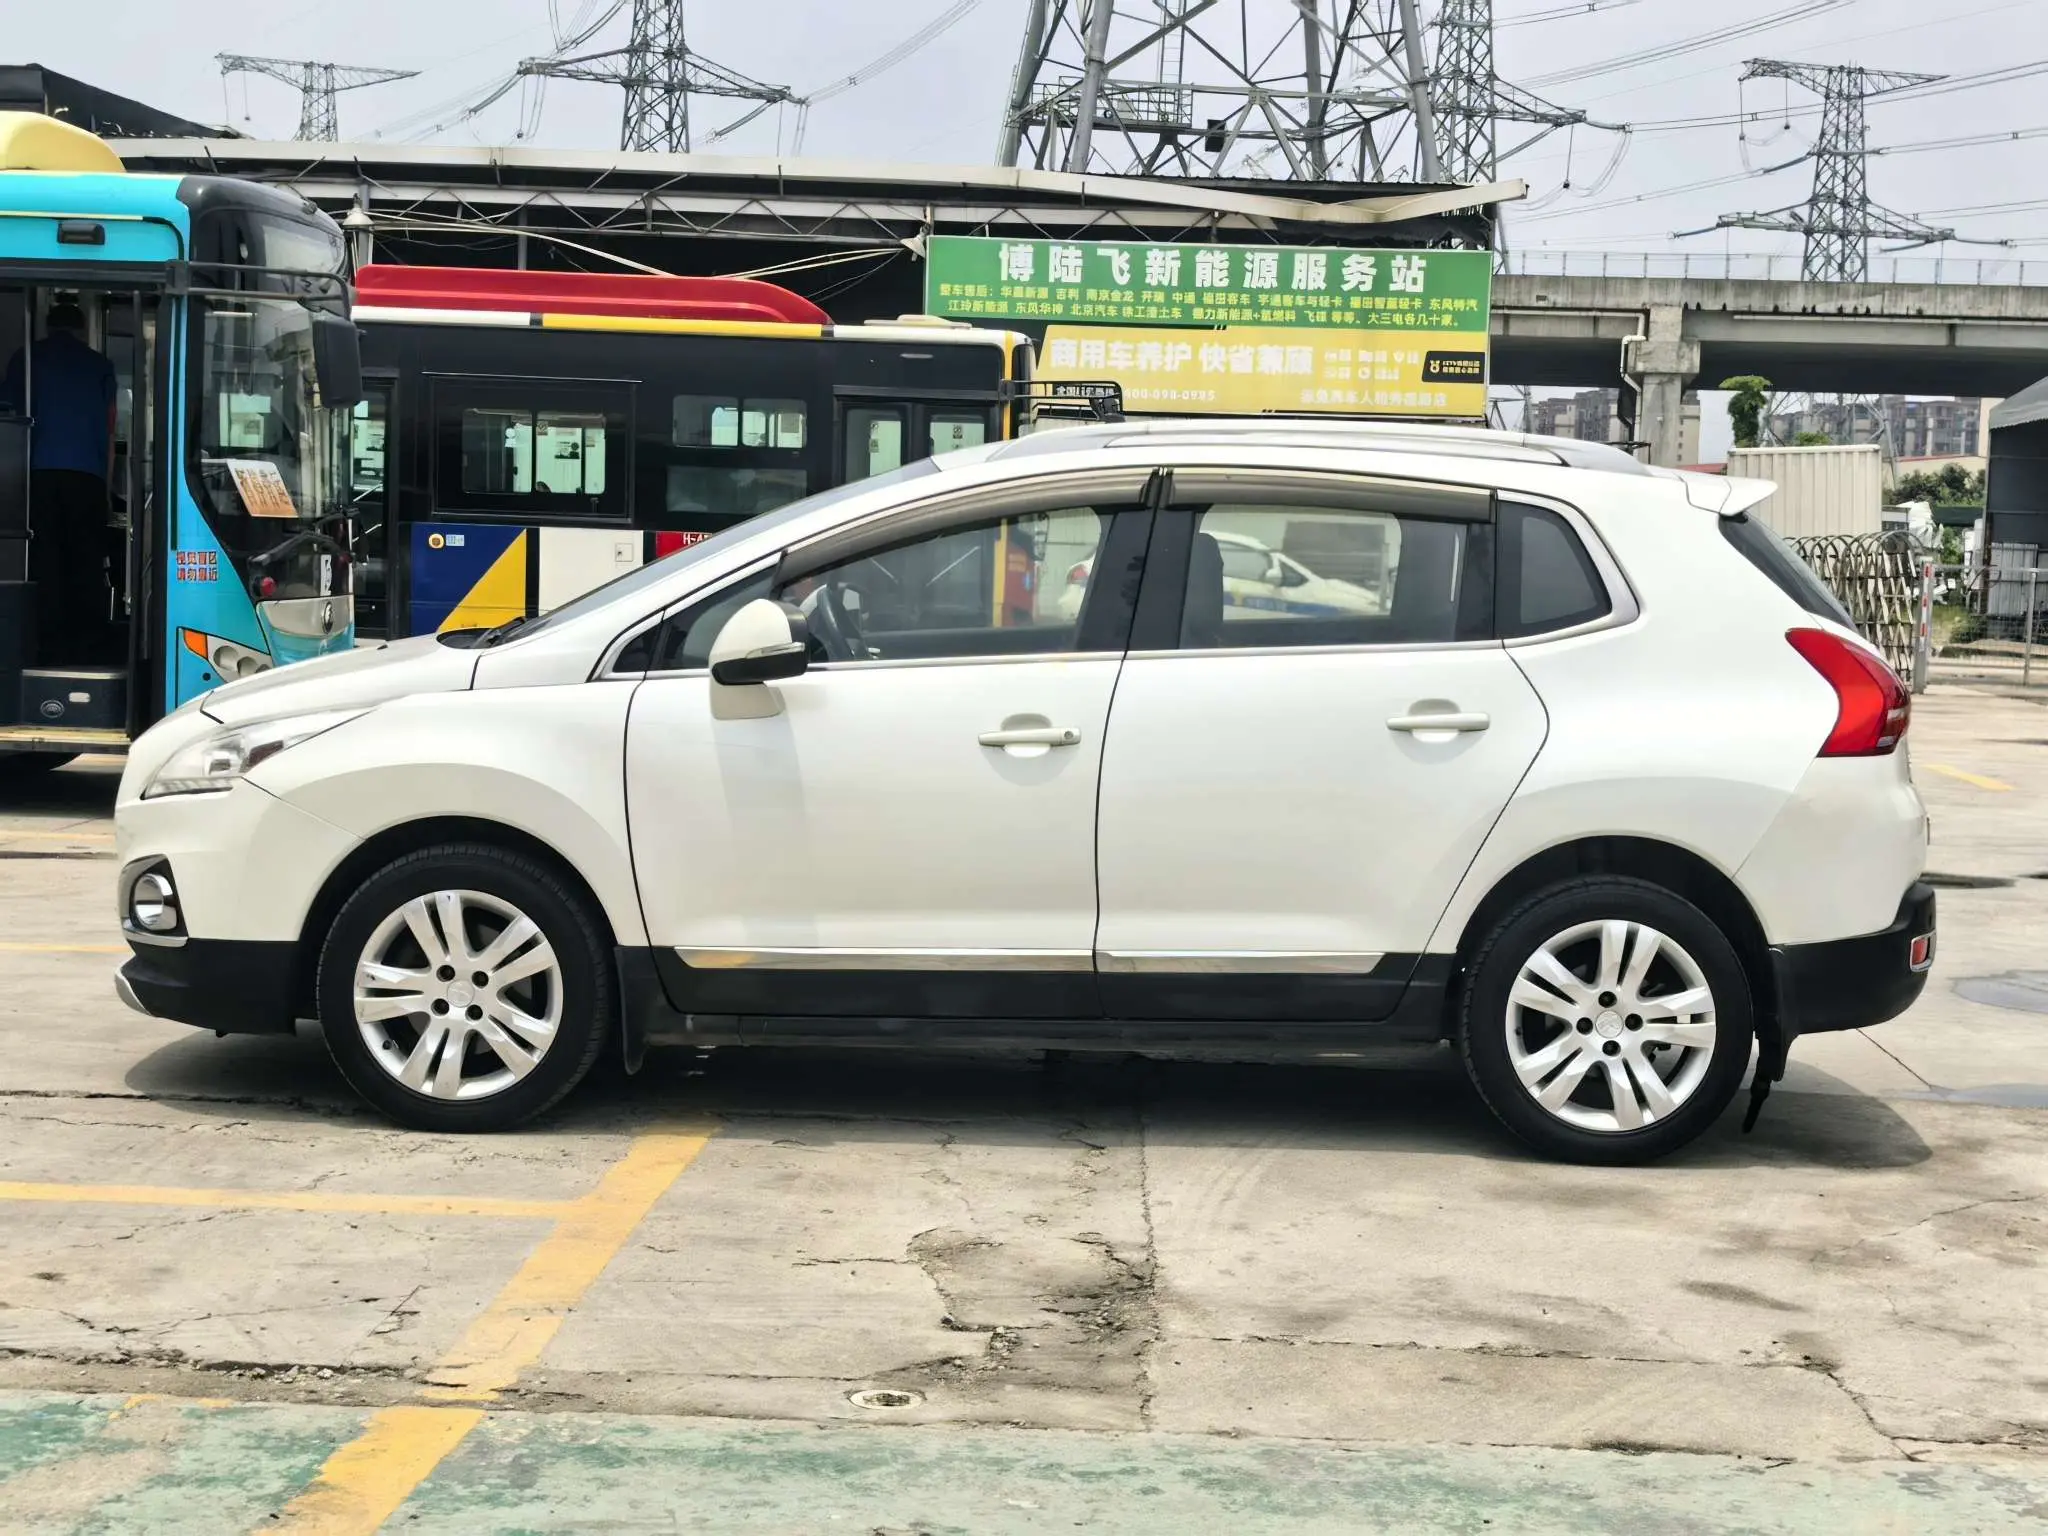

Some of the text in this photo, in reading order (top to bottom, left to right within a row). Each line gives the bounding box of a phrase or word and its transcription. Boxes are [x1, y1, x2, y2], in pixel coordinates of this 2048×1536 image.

[998, 243, 1427, 292] 博陆飞新能源服务站
[1070, 303, 1116, 317] 北京汽车
[1051, 338, 1192, 371] 商用车养护
